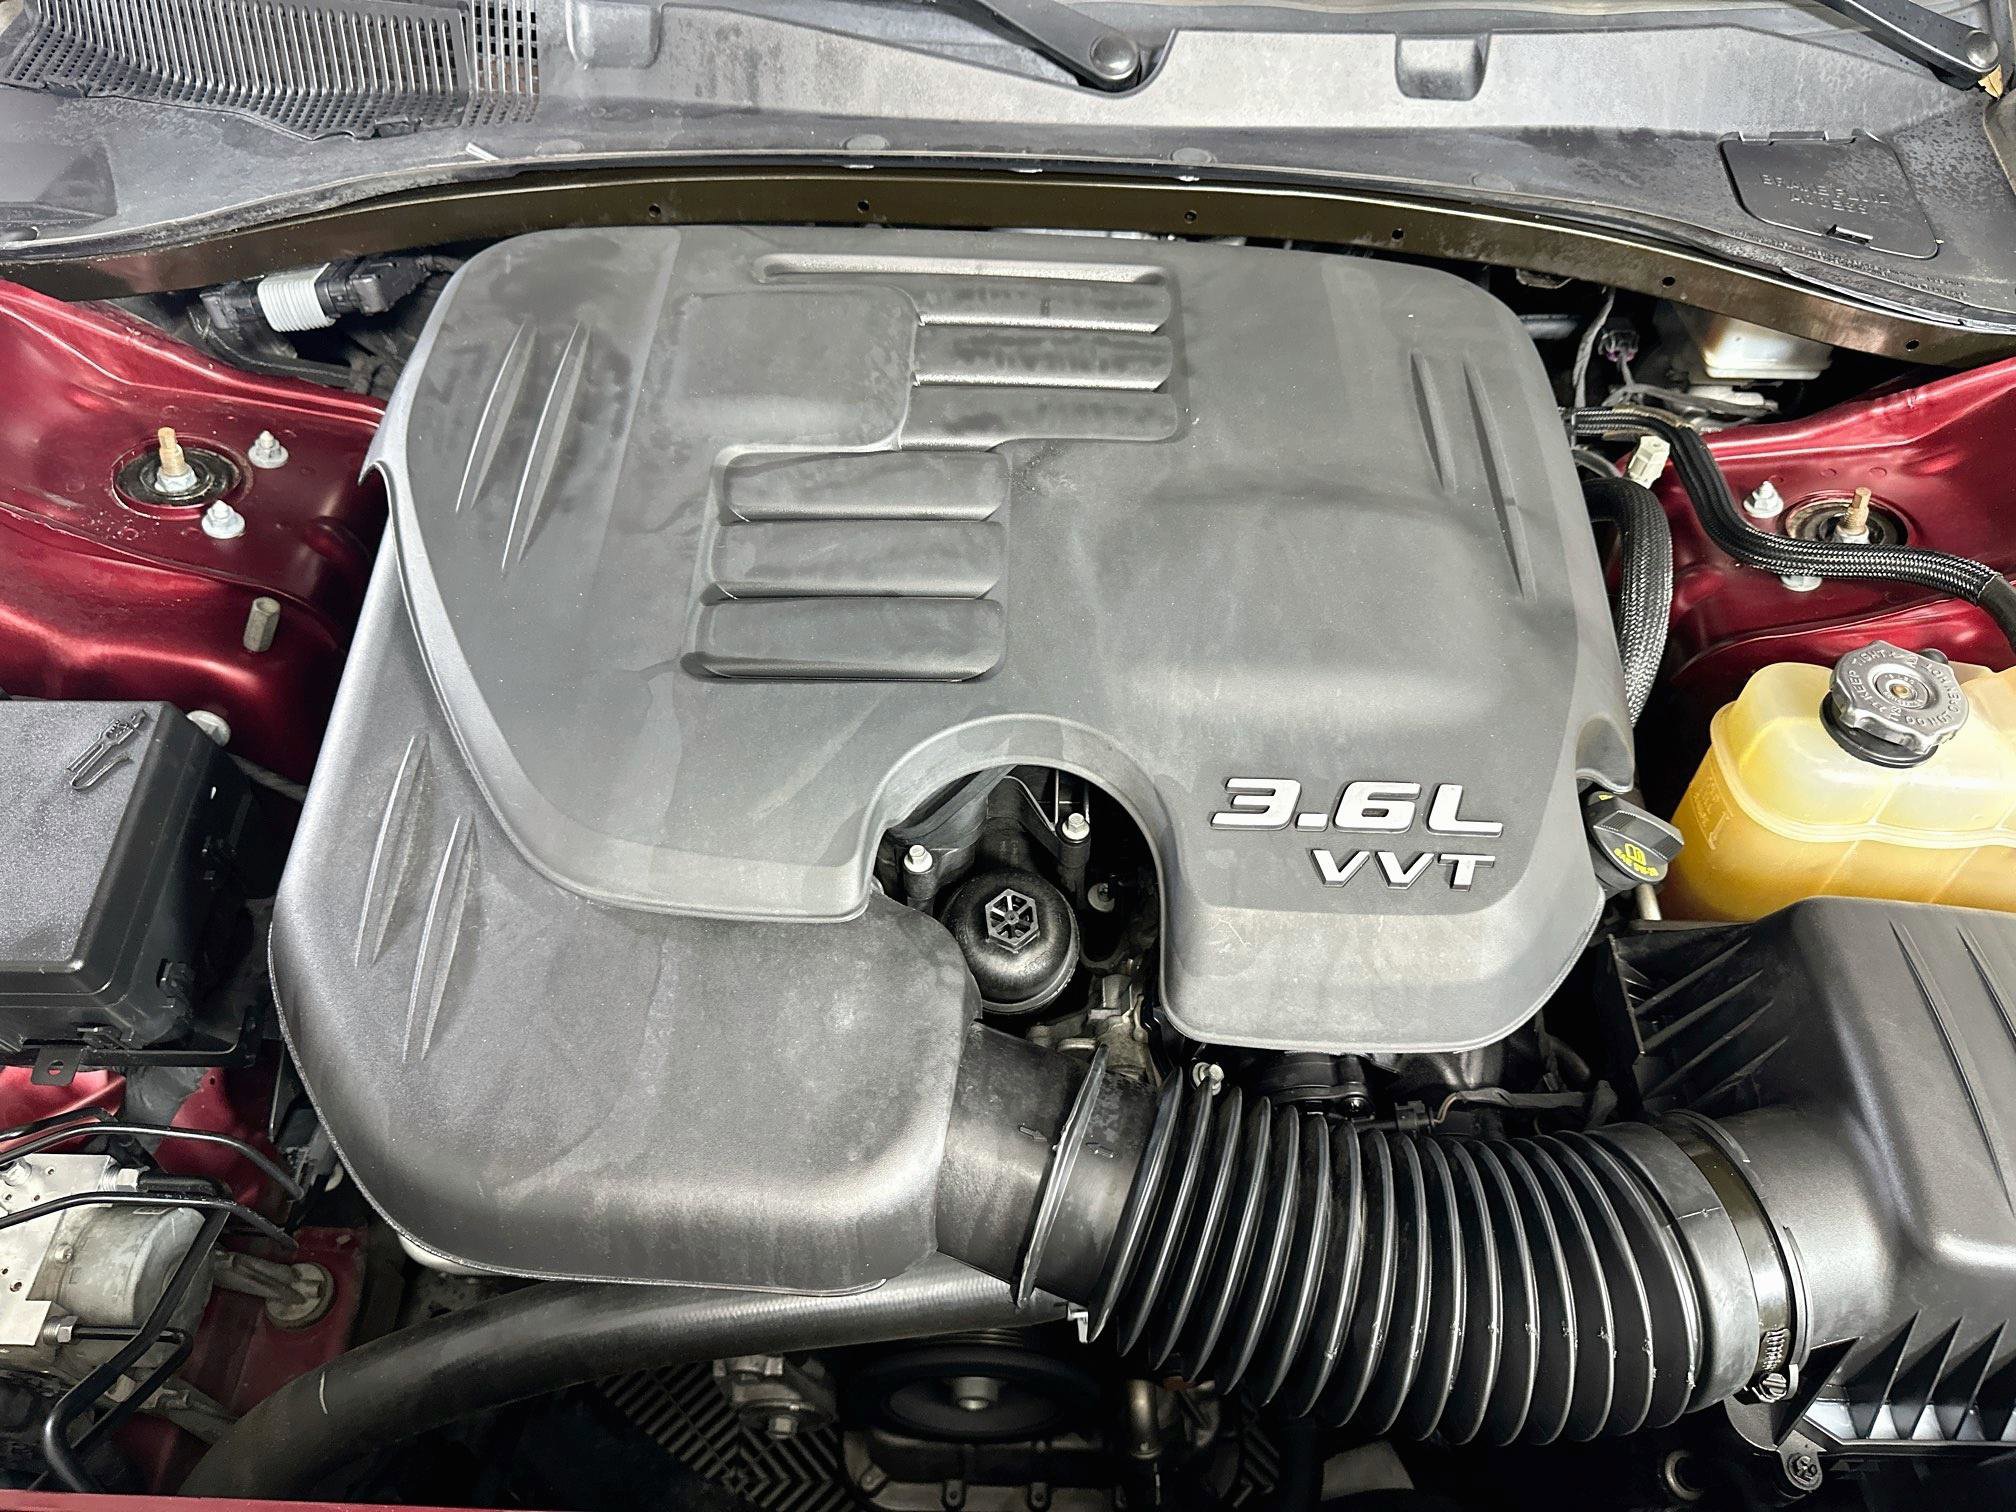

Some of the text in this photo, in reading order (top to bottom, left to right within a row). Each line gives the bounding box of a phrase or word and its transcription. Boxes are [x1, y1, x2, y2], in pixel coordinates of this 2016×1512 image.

[1848, 670, 1873, 701] KEEP
[1209, 777, 1504, 838] 3.6L
[1307, 848, 1496, 893] VVT
